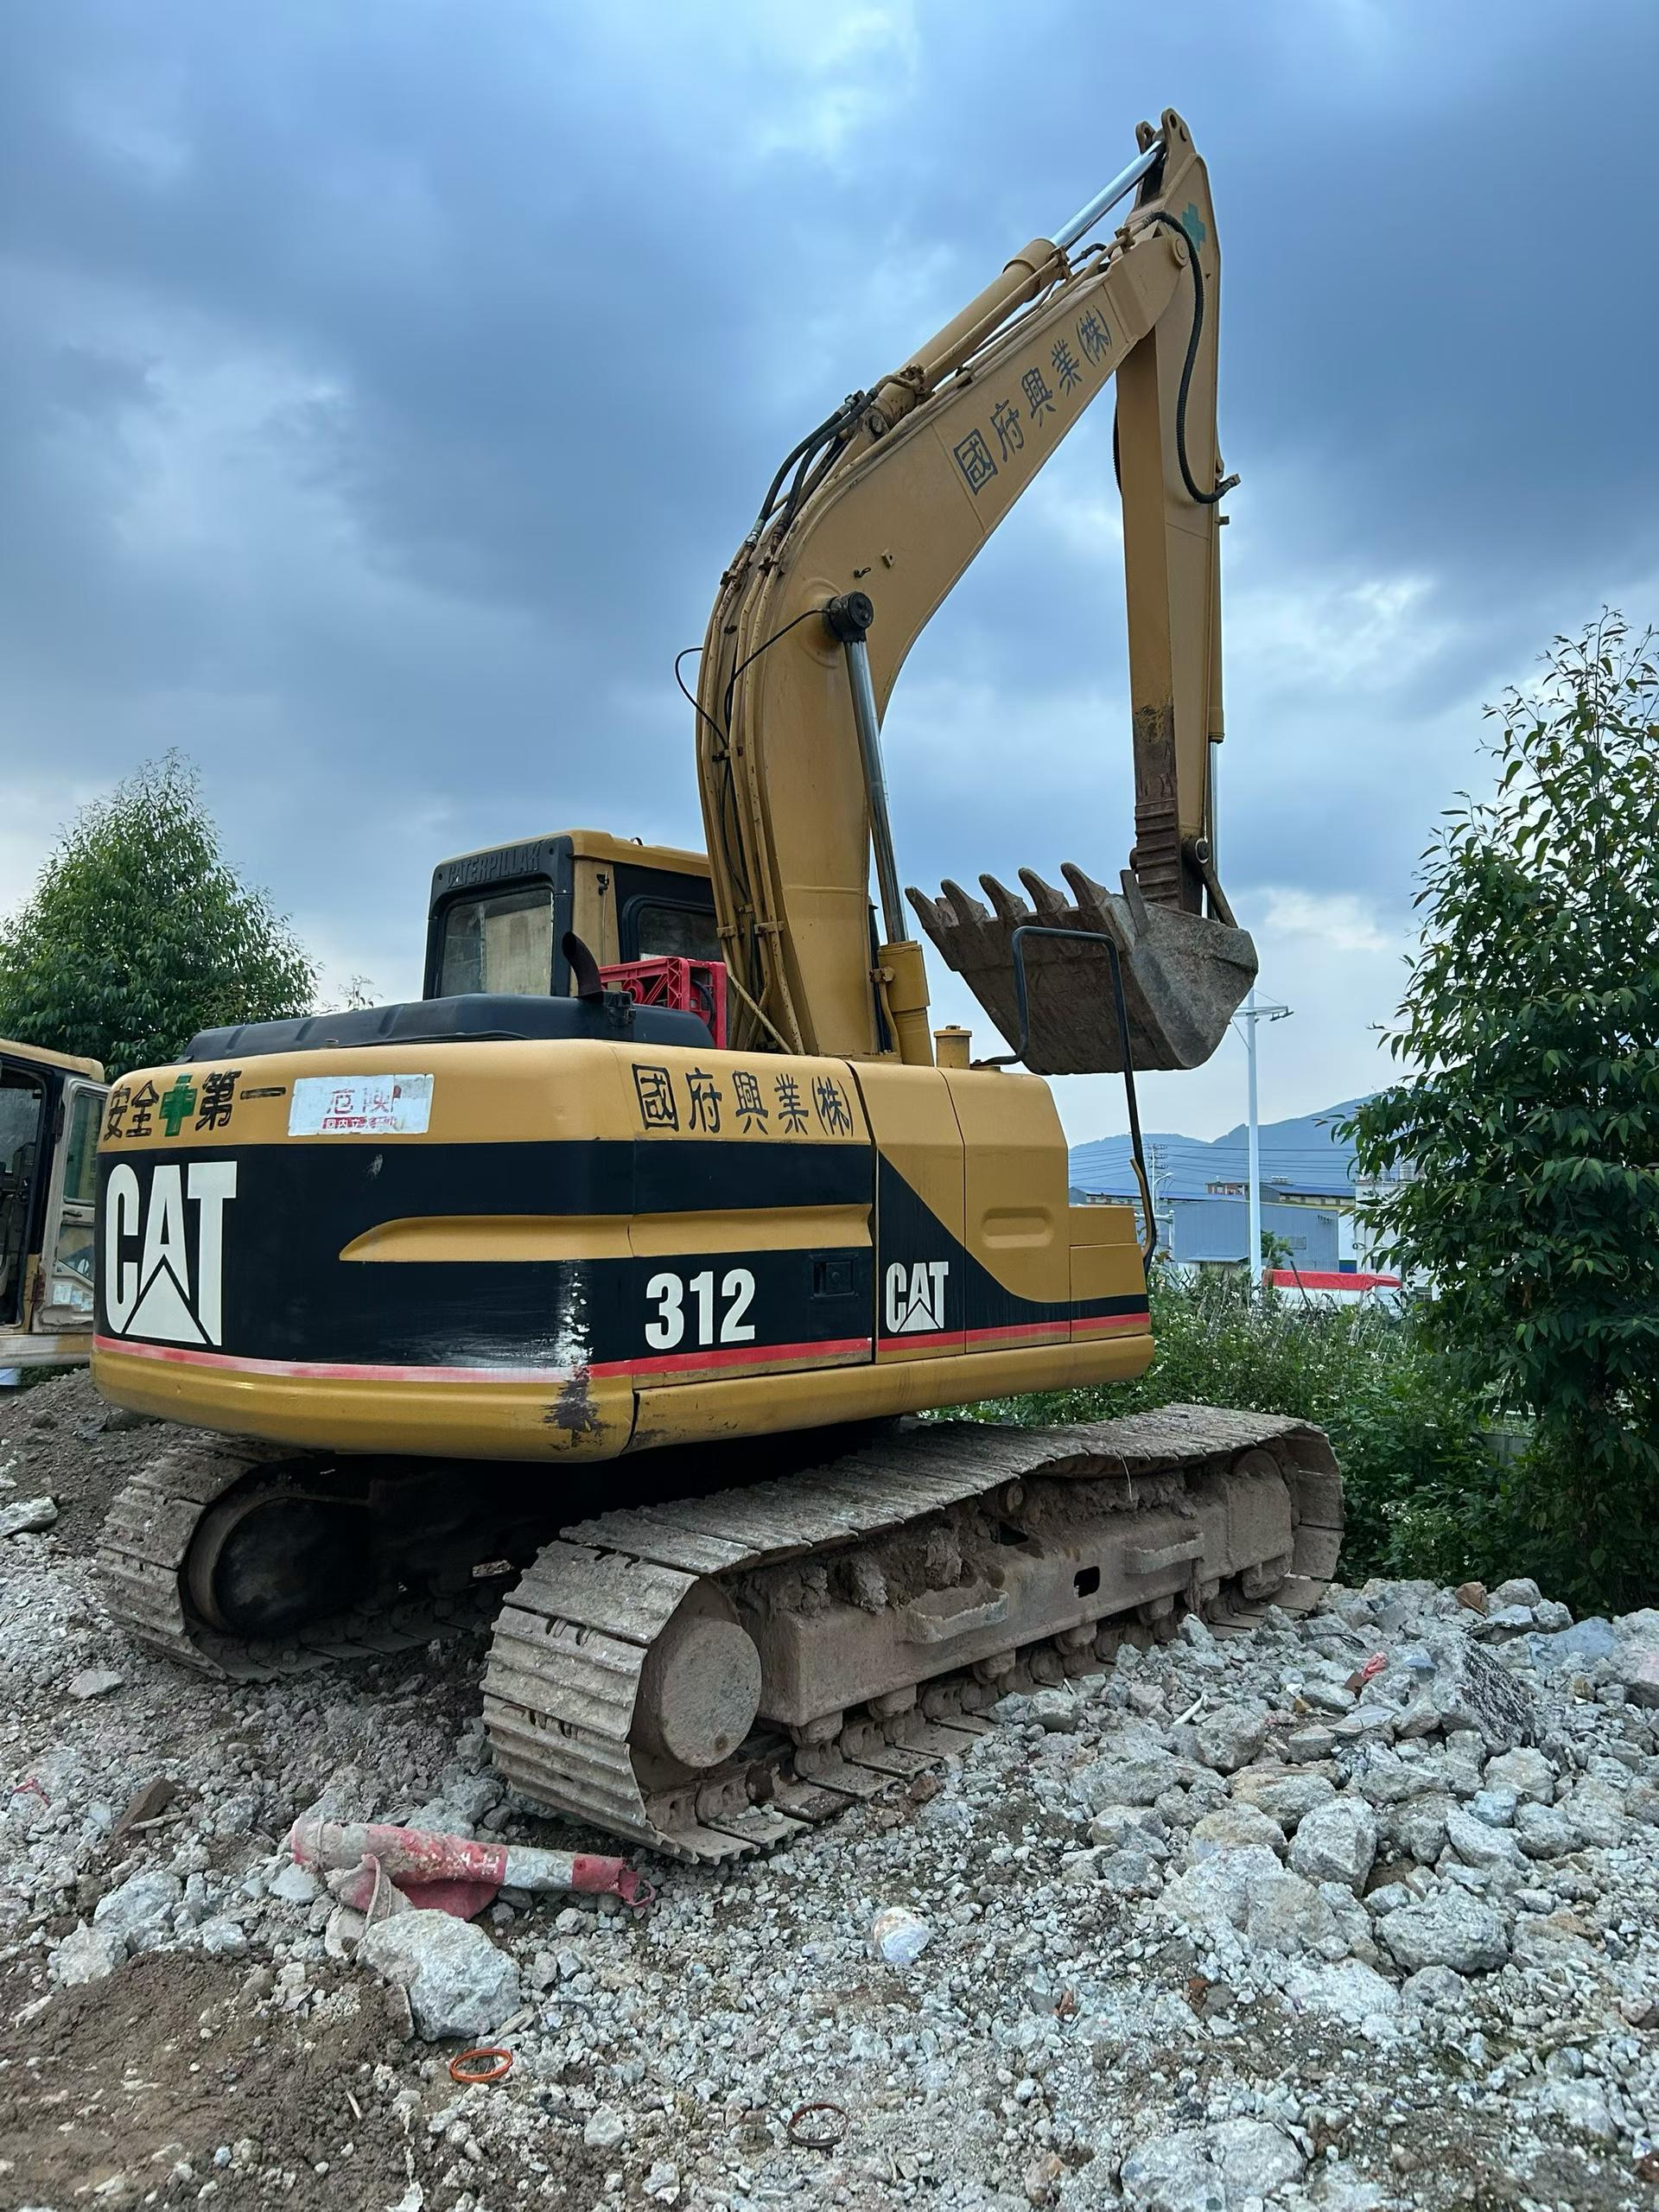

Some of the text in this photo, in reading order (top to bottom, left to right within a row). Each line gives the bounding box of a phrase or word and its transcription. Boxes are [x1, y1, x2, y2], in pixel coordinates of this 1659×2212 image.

[105, 1160, 238, 1346] CAT
[645, 1268, 756, 1350] 312
[886, 1261, 949, 1333] CAT
